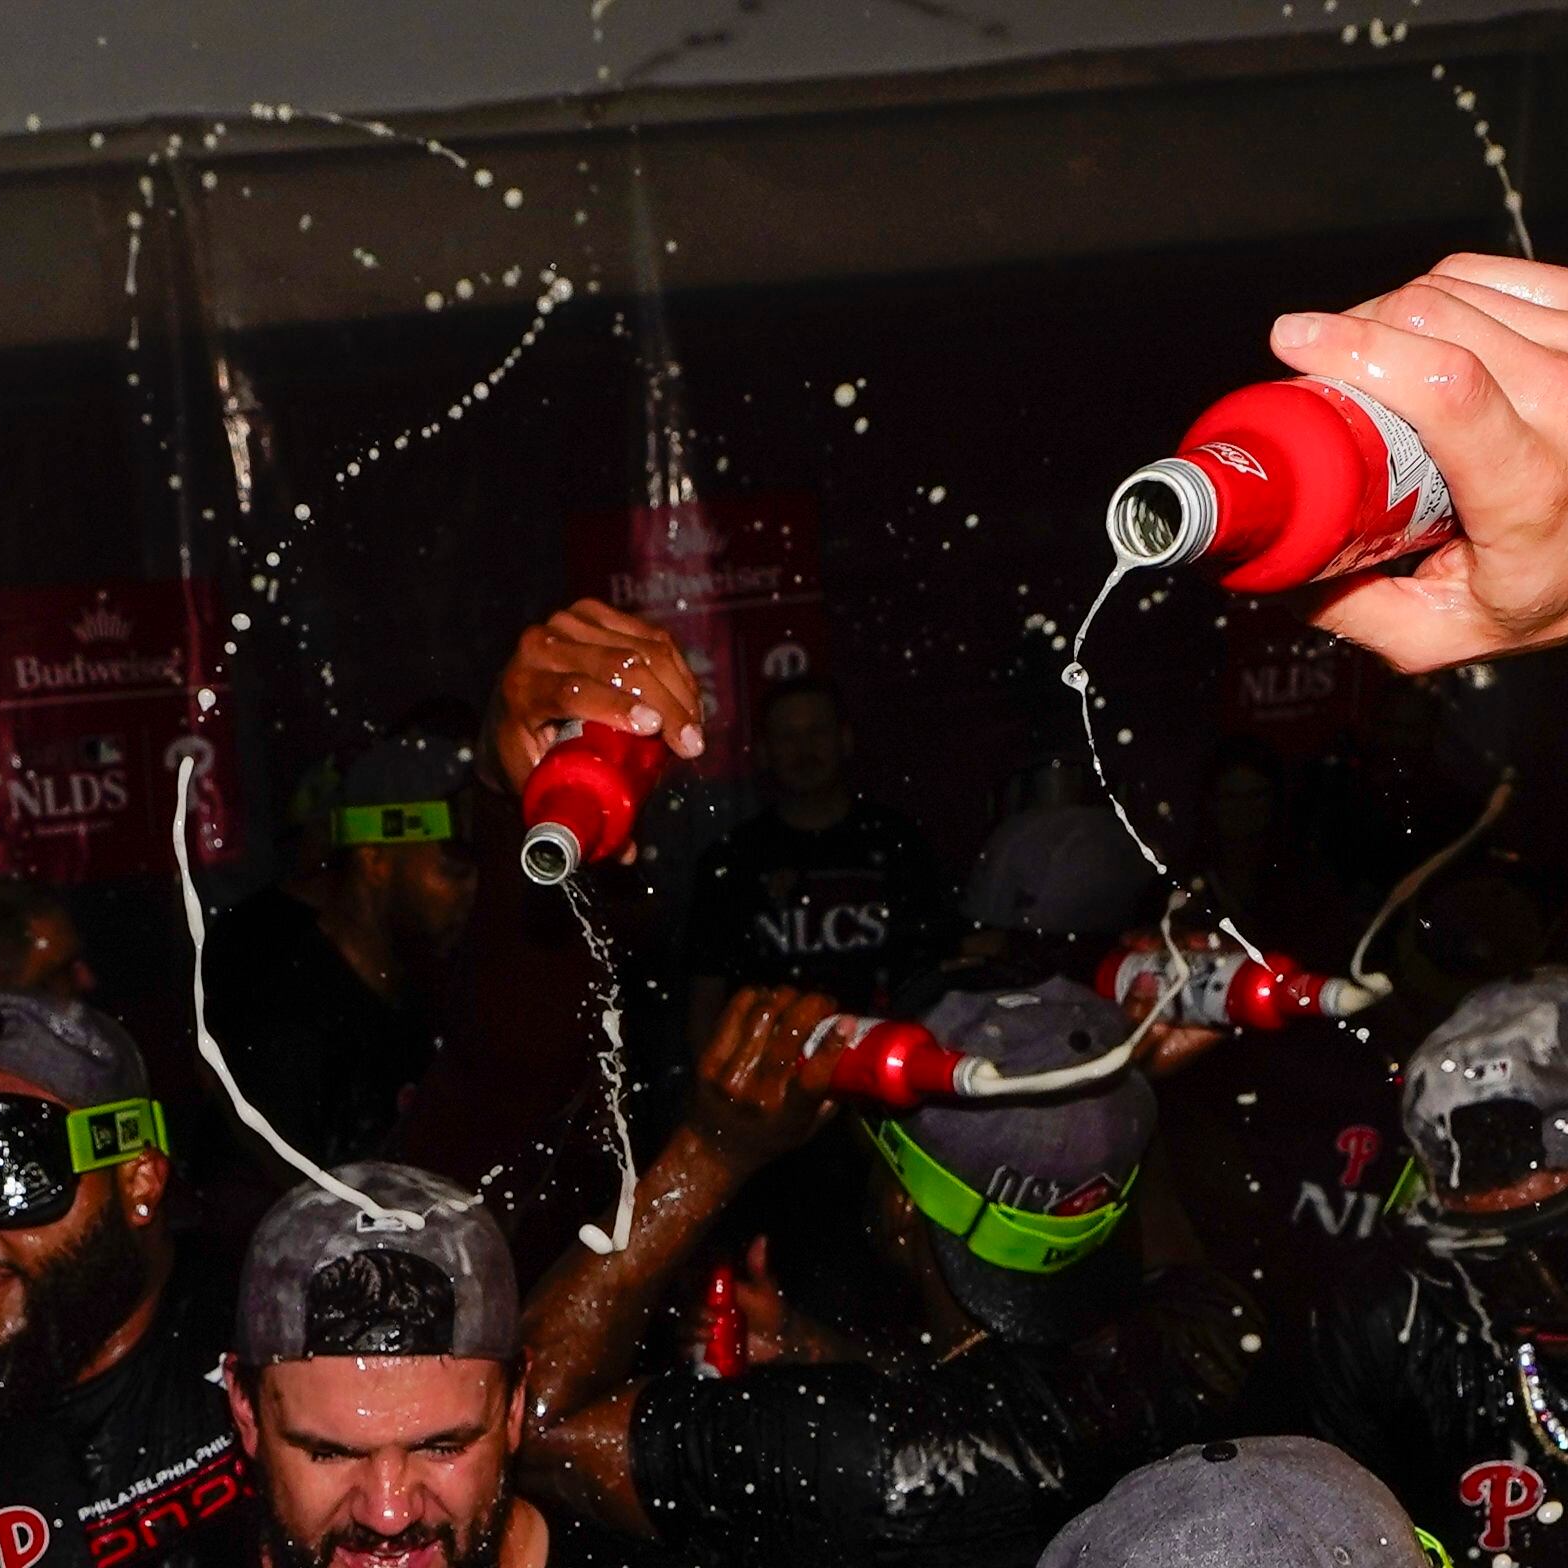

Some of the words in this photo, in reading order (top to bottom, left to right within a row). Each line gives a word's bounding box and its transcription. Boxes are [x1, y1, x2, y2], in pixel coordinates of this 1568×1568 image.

[7, 769, 130, 822] NLDS
[754, 900, 888, 954] NLCS
[1458, 1459, 1545, 1553] P
